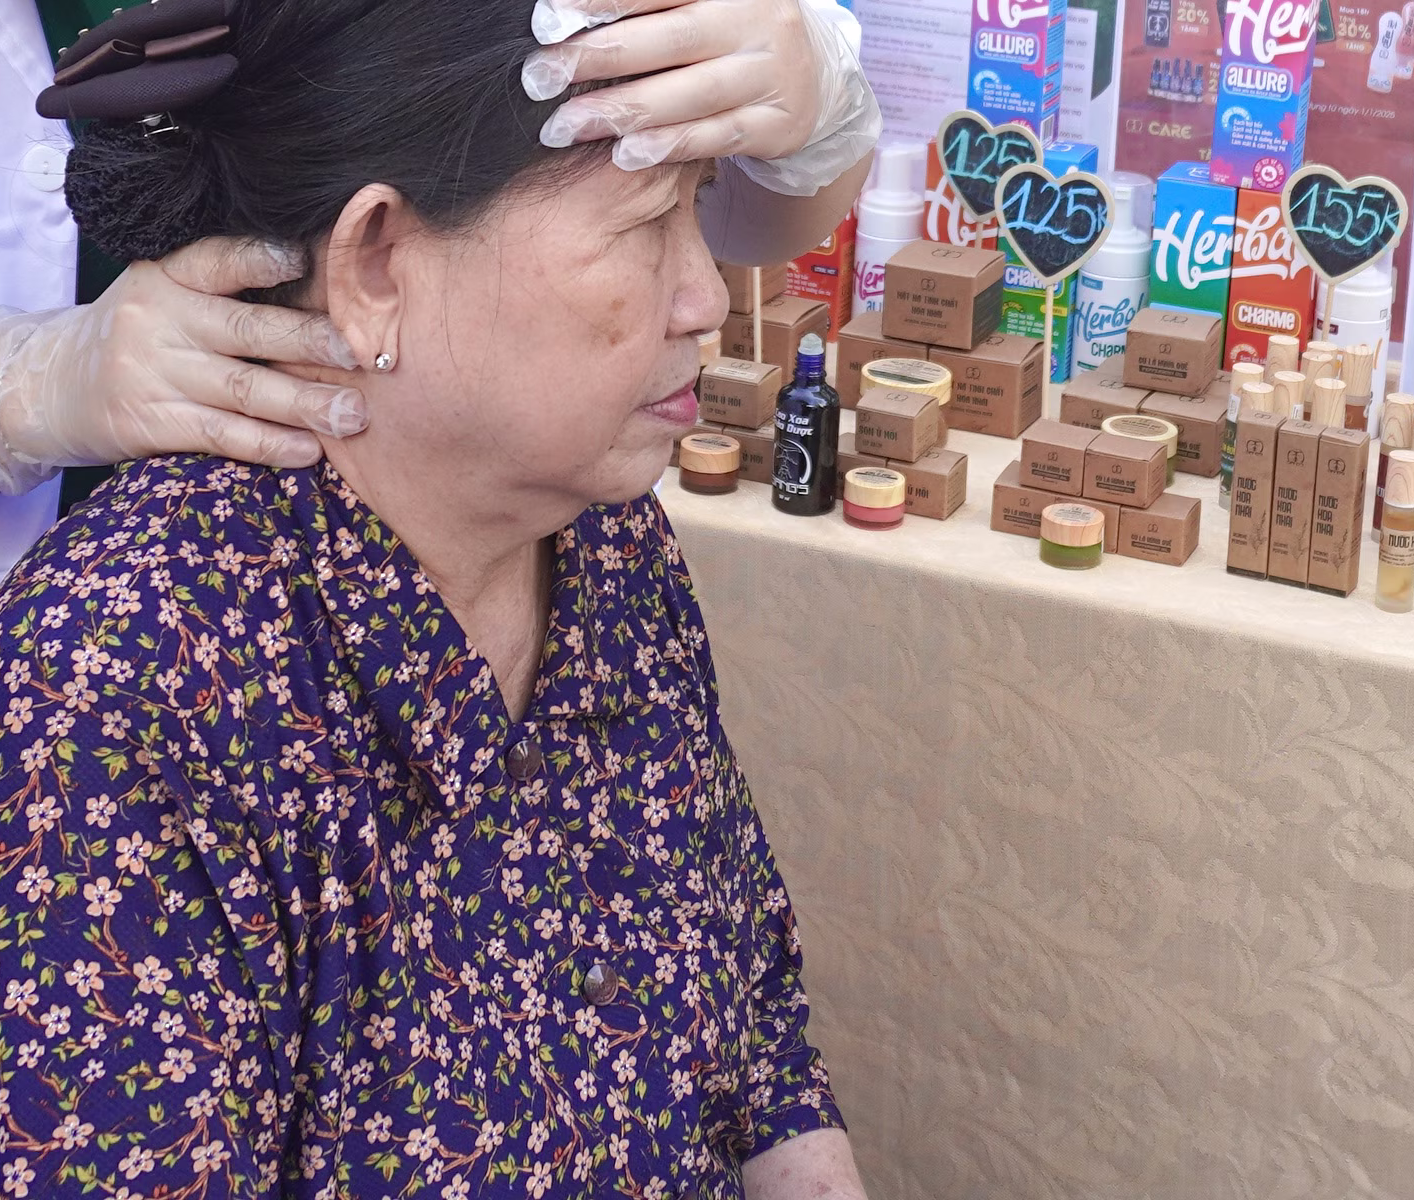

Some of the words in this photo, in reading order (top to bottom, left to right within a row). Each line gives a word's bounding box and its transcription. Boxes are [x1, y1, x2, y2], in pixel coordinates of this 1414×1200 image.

[1177, 8, 1209, 25] 20%
[1338, 24, 1371, 39] 30%
[1148, 121, 1192, 139] CARE
[944, 129, 1036, 184] 125
[787, 424, 813, 437] Dược
[1237, 490, 1251, 504] HOA
[1277, 500, 1292, 514] HOA
[1317, 508, 1332, 522] HOA
